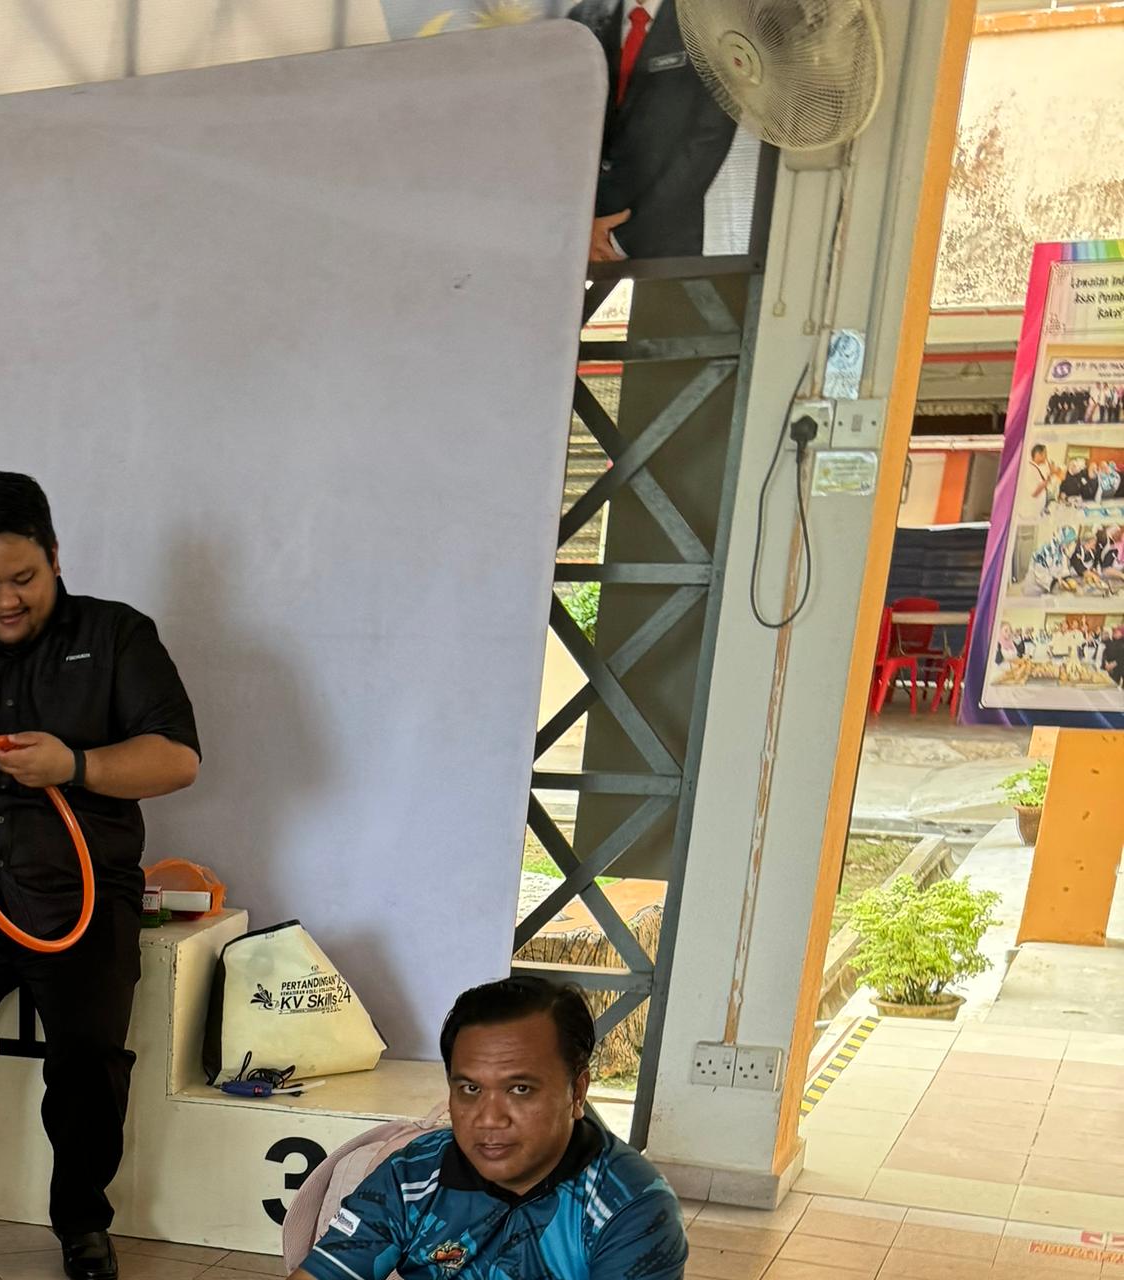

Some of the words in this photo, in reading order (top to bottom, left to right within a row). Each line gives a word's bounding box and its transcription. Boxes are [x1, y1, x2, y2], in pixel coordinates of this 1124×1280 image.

[280, 995, 304, 1010] KV
[307, 992, 337, 1008] Skills
[338, 985, 351, 1003] 24
[262, 1136, 328, 1226] 3
